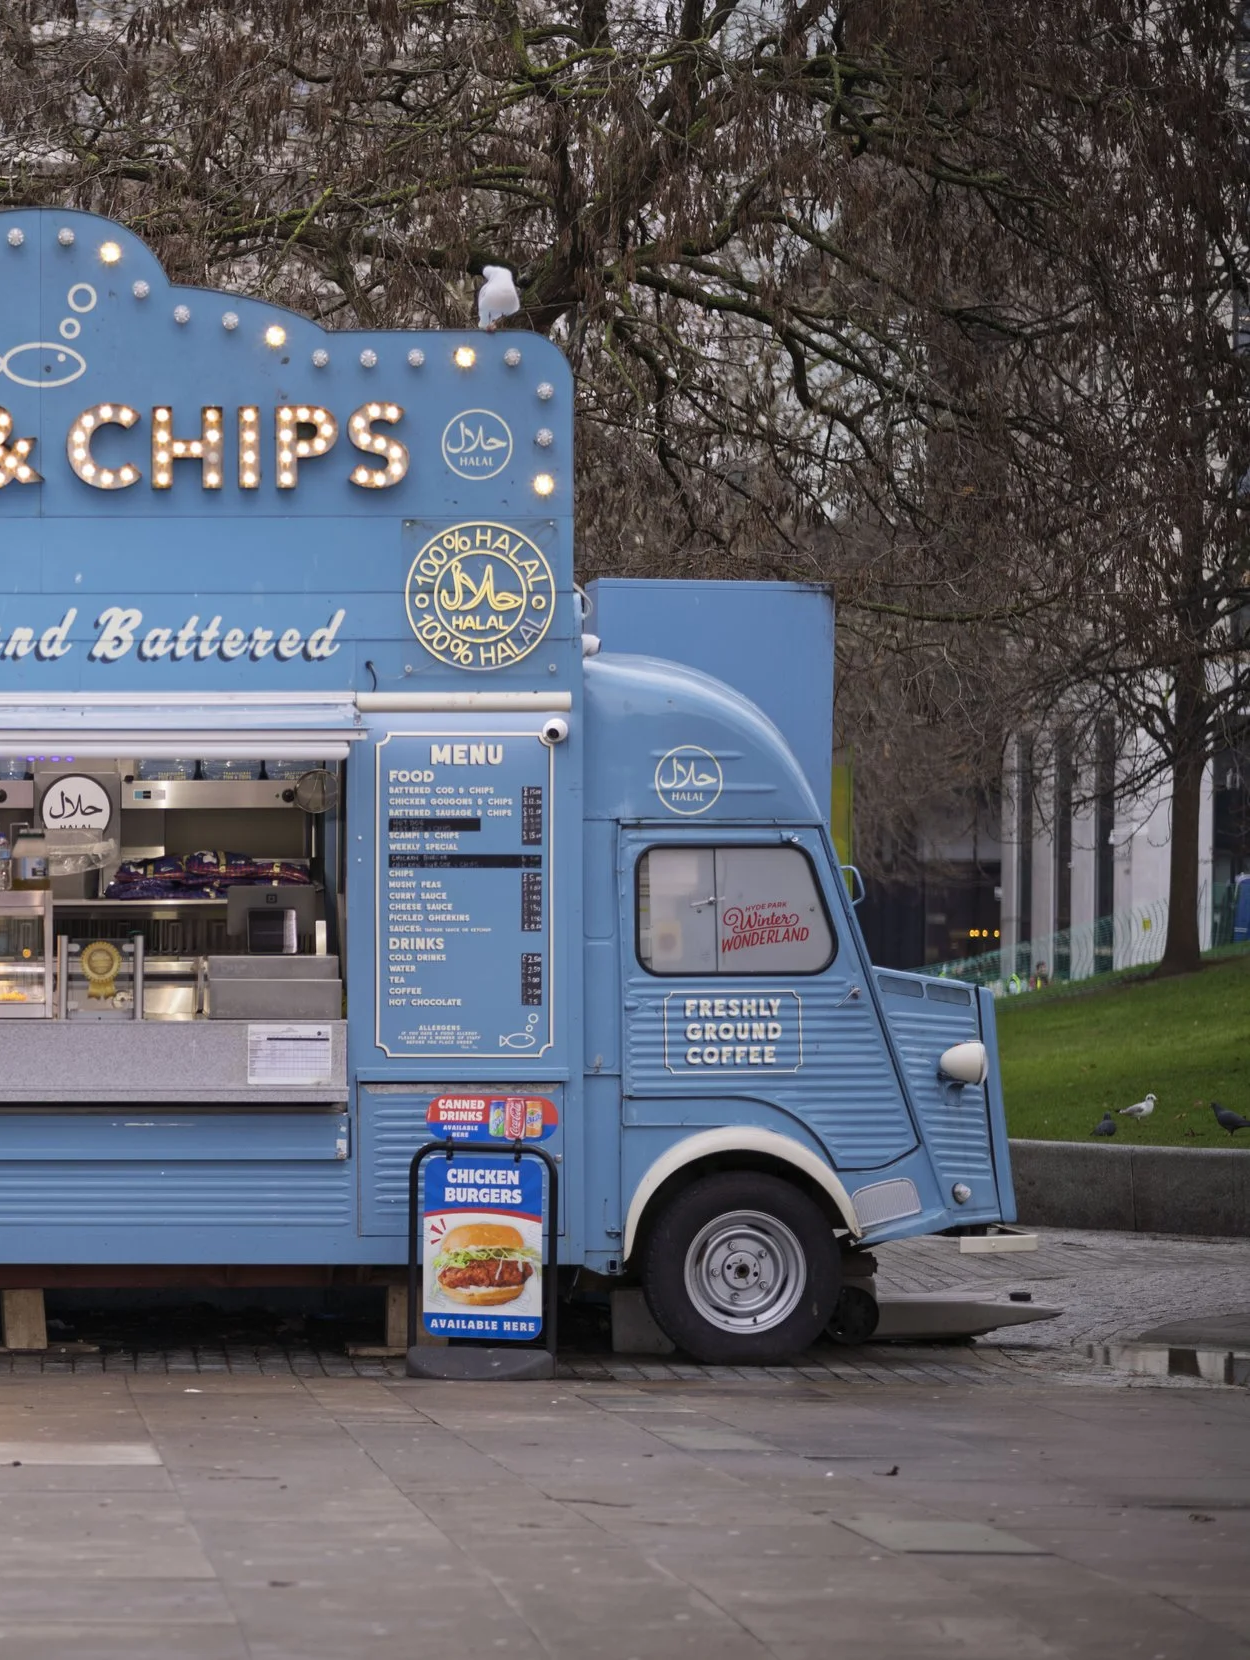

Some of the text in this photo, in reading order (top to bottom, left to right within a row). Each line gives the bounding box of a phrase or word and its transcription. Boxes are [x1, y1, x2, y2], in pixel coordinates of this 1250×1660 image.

[66, 402, 410, 490] CHIPS
[446, 420, 509, 454] حلال
[459, 456, 495, 467] HALAL
[414, 528, 548, 592] 100% HALAL
[451, 615, 511, 631] HALAL
[88, 606, 347, 663] Battered
[416, 613, 547, 666] 100% HALAL
[430, 743, 504, 766] MENU
[388, 769, 435, 783] FOOD
[670, 791, 705, 803] HALAL
[745, 901, 787, 912] HYDE PARK
[723, 907, 800, 933] Winter
[388, 937, 445, 950] DRINKS
[722, 927, 810, 953] WONDERLAND
[389, 998, 462, 1006] HOT CHOCOLATE
[684, 999, 782, 1018] FRESHLY
[685, 1022, 783, 1042] GROUND
[685, 1046, 778, 1065] COFFEE
[438, 1099, 485, 1110] CANNED
[439, 1111, 483, 1121] DRINKS
[446, 1168, 520, 1186] CHICKEN
[444, 1187, 523, 1204] BURGERS
[430, 1318, 536, 1332] AVAILABLE HERE
